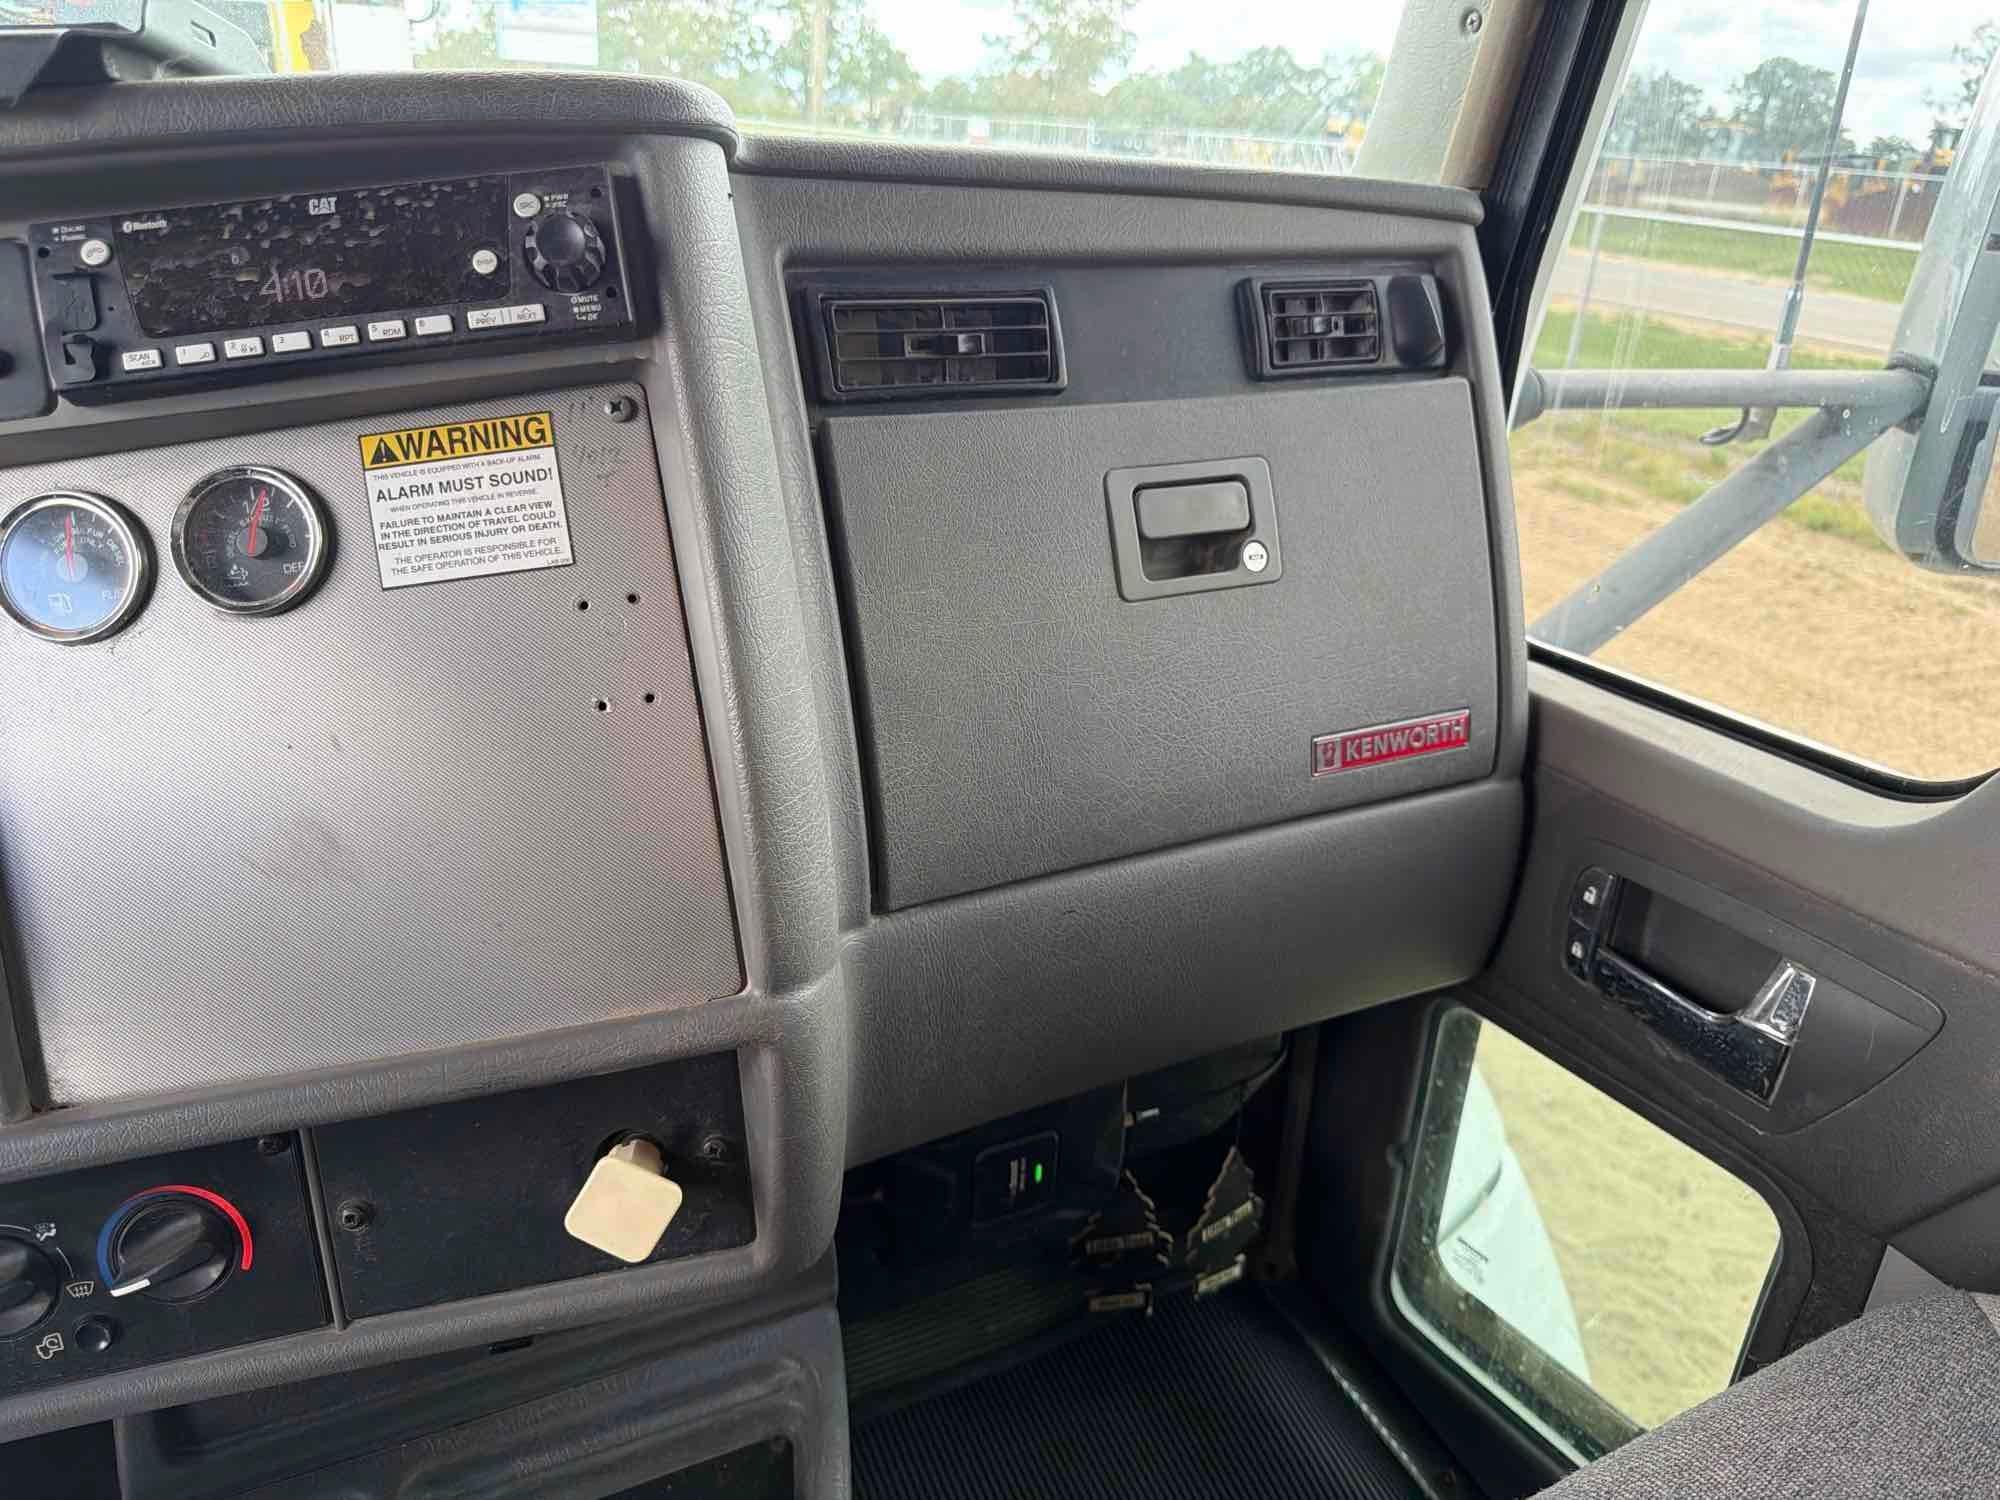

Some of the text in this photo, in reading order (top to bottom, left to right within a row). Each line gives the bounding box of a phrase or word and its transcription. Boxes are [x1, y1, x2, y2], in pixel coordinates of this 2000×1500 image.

[308, 197, 337, 215] CAT
[259, 266, 328, 303] 4:10
[128, 352, 151, 362] SCAN
[395, 417, 547, 460] WARNING
[375, 468, 553, 502] ALARM MUST SOUND!
[380, 501, 553, 529] FAILURE TO MAINTAIN A CLEAR VIEW
[381, 511, 556, 540] IN THE DIRECTION OF TRAVEL COULD
[379, 521, 562, 551] RESULT IN SERIOUS INJURY OR DEATH.
[392, 567, 408, 576] THE
[411, 564, 432, 573] SAFE
[435, 557, 486, 570] OPERATION
[488, 555, 500, 563] OF
[502, 552, 521, 561] THIS
[395, 556, 412, 565] THE
[414, 550, 462, 563] OPERATOR
[464, 548, 472, 556] IS
[475, 540, 535, 555] RESPONSIBLE
[1346, 718, 1465, 762] KENWORTH
